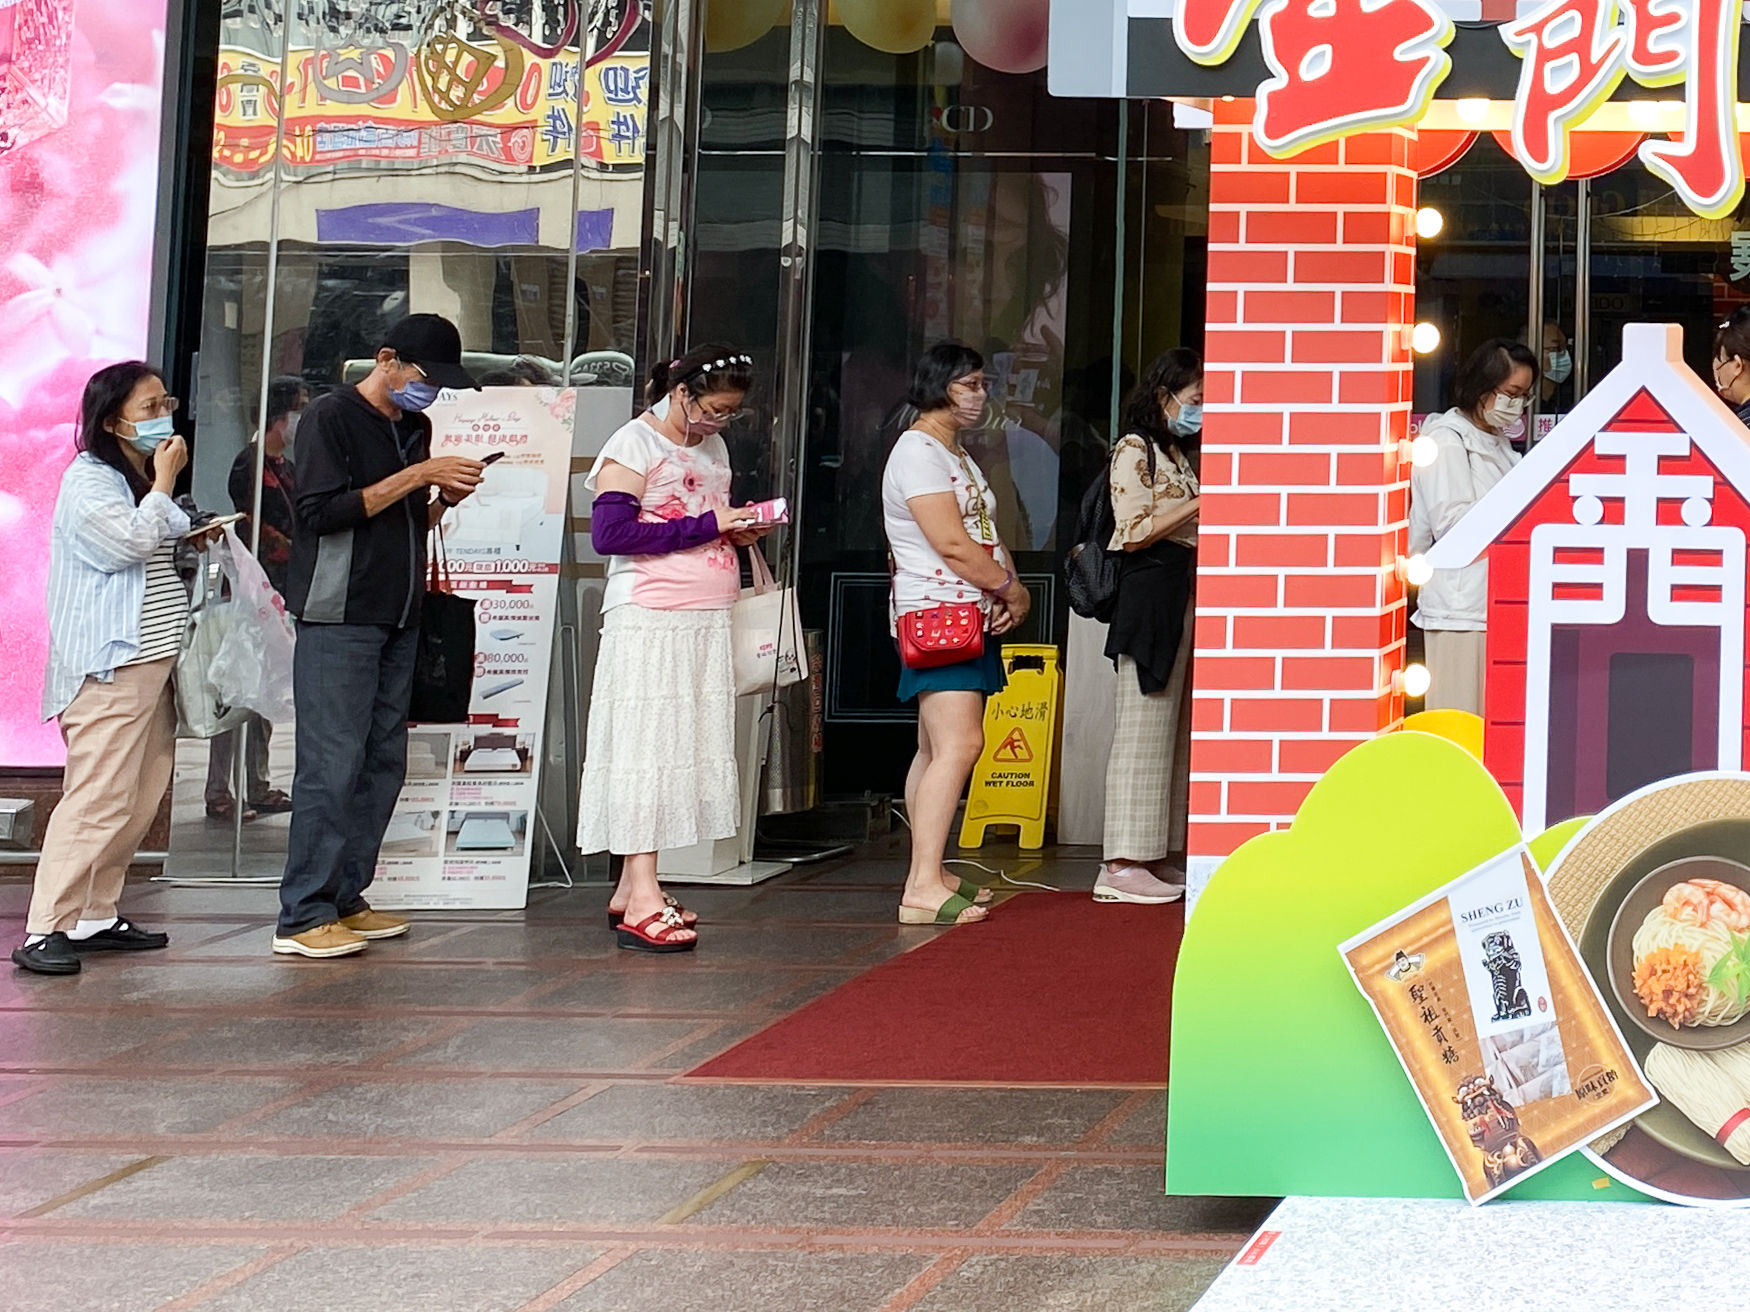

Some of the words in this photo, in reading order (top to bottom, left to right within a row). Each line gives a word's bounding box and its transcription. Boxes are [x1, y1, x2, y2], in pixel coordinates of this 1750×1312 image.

[991, 701, 1049, 722] 小心地滑
[991, 771, 1030, 779] CAUTION
[1460, 902, 1505, 923] SHENG
[1506, 896, 1525, 911] ZU
